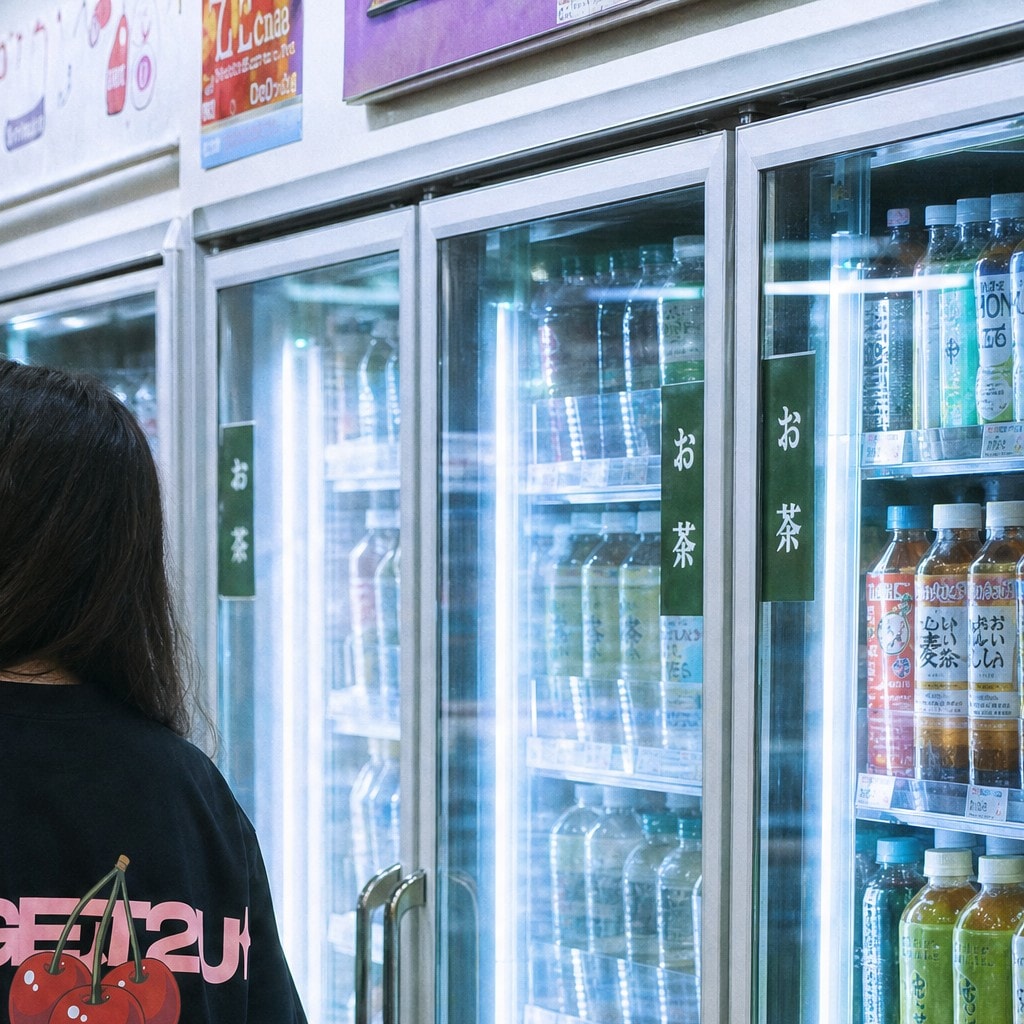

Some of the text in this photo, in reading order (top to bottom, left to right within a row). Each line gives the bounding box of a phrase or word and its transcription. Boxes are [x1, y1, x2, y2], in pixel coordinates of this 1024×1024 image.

[230, 456, 250, 564] お茶
[672, 427, 697, 569] お茶
[775, 405, 803, 553] お茶
